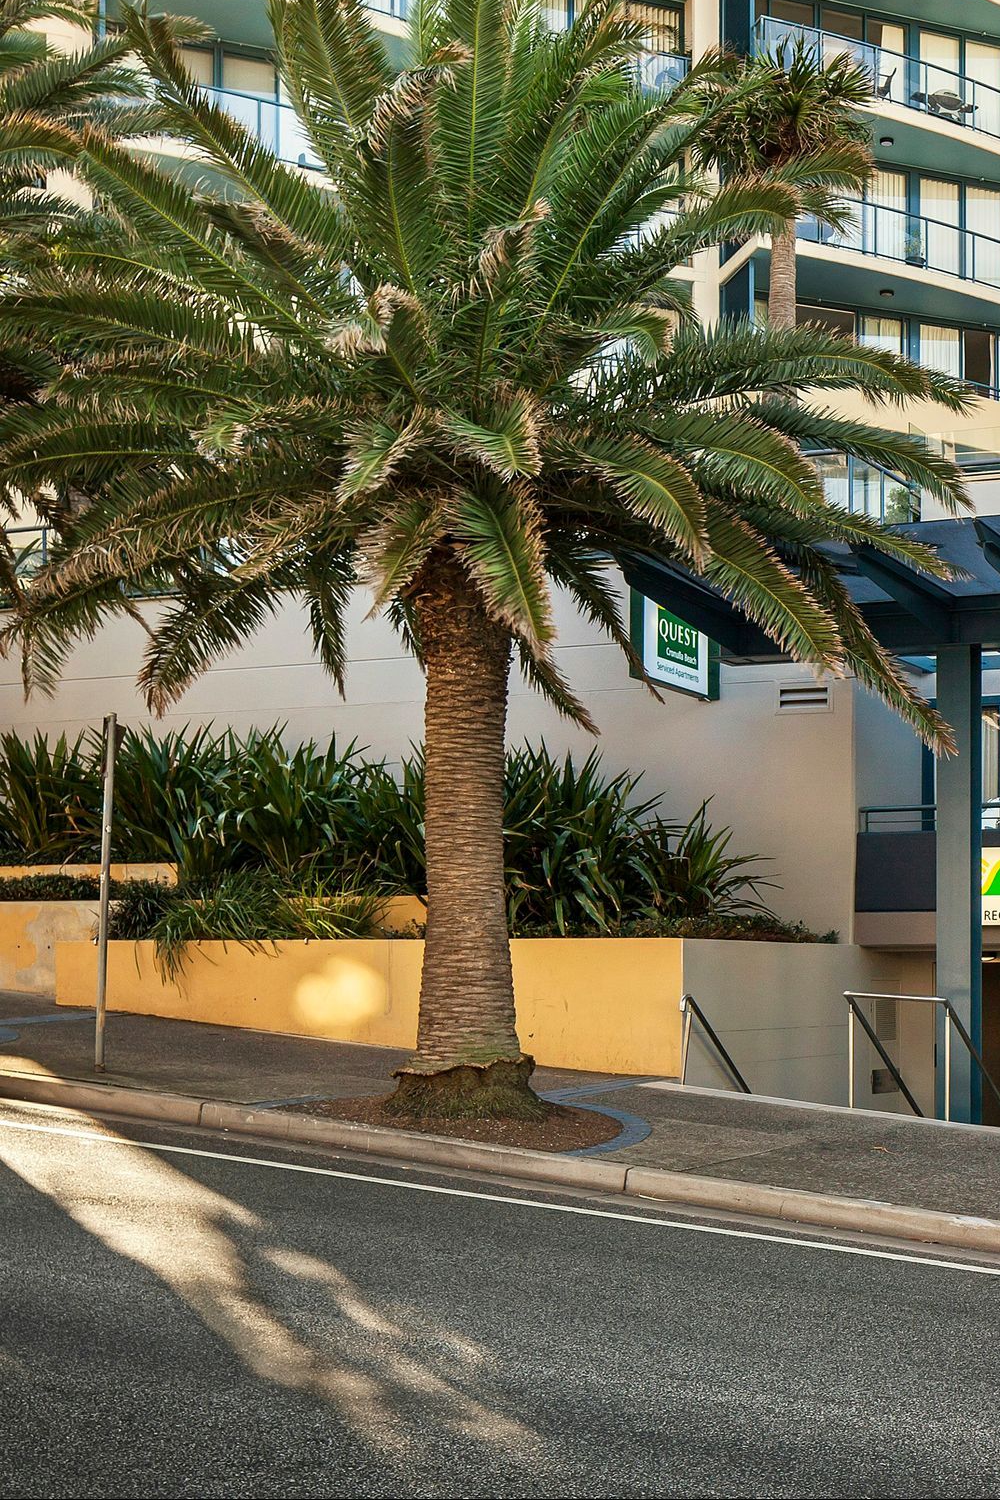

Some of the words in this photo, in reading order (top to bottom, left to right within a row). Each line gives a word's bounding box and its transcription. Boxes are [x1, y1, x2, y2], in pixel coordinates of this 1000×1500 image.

[659, 618, 698, 649] QUEST
[684, 653, 697, 666] Beach
[656, 661, 675, 675] Serviced
[675, 667, 699, 684] Apartments
